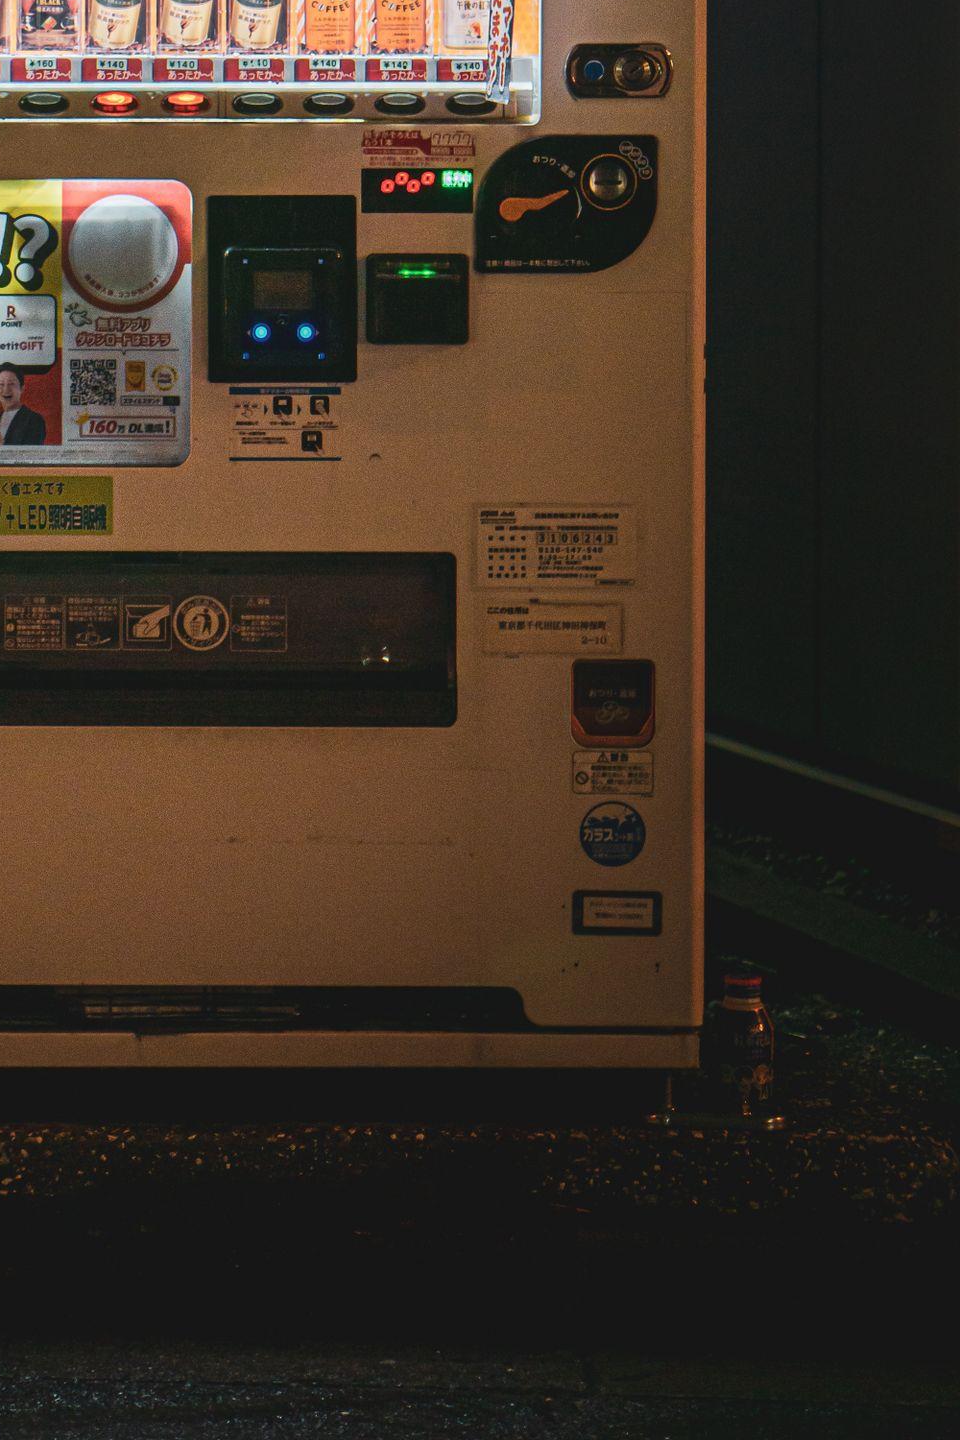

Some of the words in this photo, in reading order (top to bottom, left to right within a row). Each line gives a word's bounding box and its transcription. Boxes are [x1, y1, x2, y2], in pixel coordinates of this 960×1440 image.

[456, 0, 490, 11] 午後の紅
[29, 60, 53, 68] ¥160
[99, 60, 124, 68] ¥140
[170, 60, 194, 68] ¥140
[312, 60, 336, 68] ¥140
[6, 306, 16, 318] R
[94, 317, 150, 332] 無料アプリ
